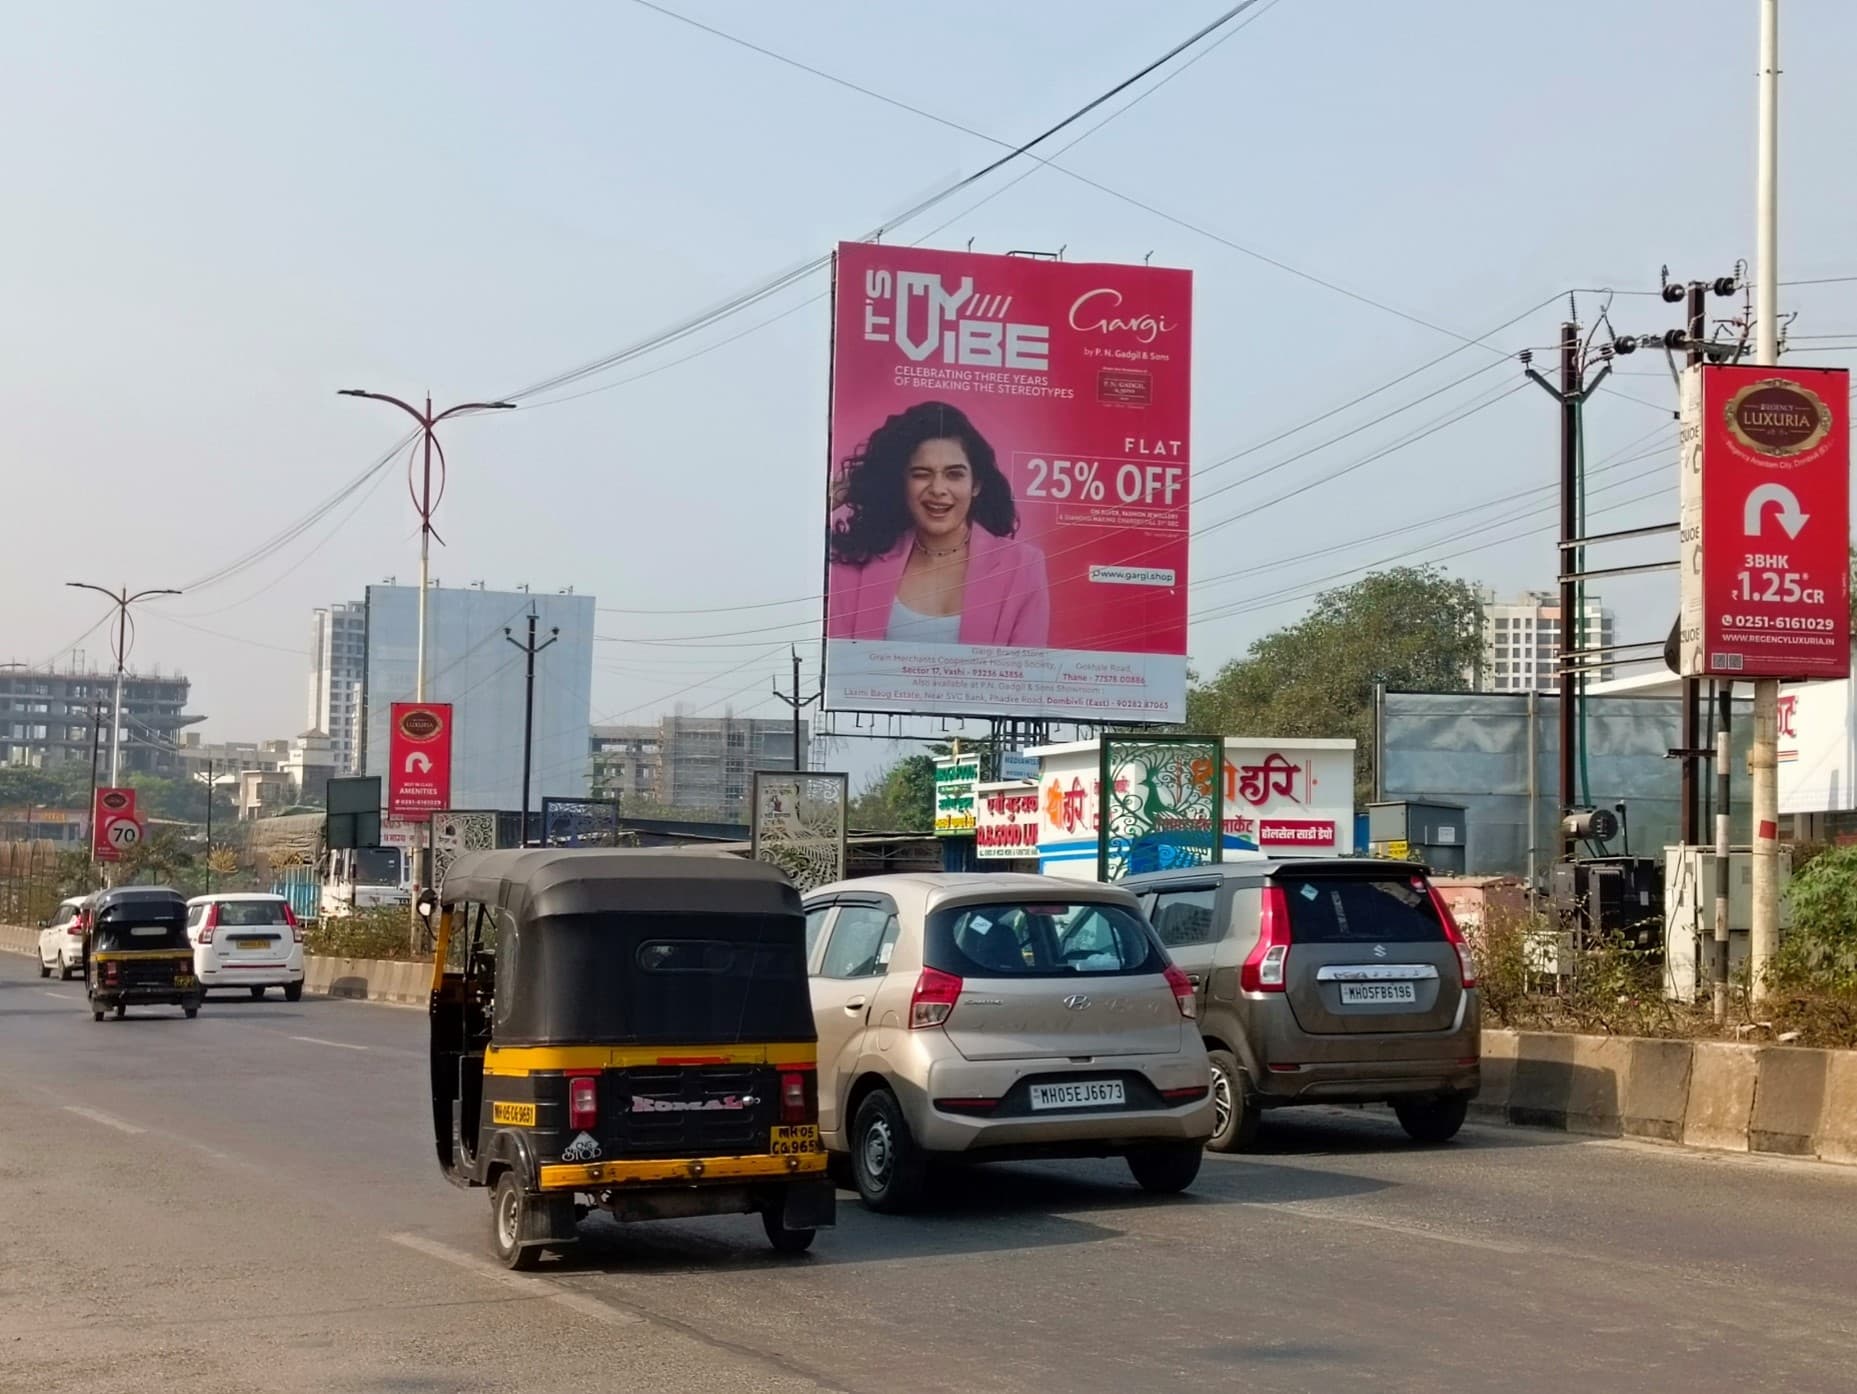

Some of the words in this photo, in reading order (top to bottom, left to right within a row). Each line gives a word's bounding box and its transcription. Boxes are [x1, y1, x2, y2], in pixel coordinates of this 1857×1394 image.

[896, 270, 974, 320] MY
[864, 269, 892, 342] IT'S
[1068, 287, 1179, 344] Gargi
[1084, 347, 1094, 357] by
[1115, 349, 1141, 360] Gadgil
[1150, 352, 1170, 361] Sons
[895, 365, 972, 381] CELEBRATING
[974, 371, 1010, 383] THREE
[1012, 374, 1048, 386] YEARS
[894, 376, 909, 387] OF
[913, 378, 970, 391] BREAKING
[973, 382, 995, 393] THE
[997, 384, 1074, 399] STEREOTYPES
[1760, 403, 1794, 412] REGENCY
[1743, 411, 1811, 428] LUXURIA
[1124, 438, 1182, 456] FLAT
[1026, 458, 1105, 500] 25%
[1116, 464, 1183, 505] OFF
[1744, 553, 1789, 569] 3BHK
[1100, 570, 1173, 582] www.gargi.shop
[1735, 615, 1834, 630] 0251-6161029
[1722, 633, 1835, 646] WWW.REGENCYLUXURIA.IN
[902, 666, 929, 674] Sector
[944, 668, 965, 676] Vashi
[1063, 673, 1087, 682] Thane
[912, 678, 933, 687] Also
[934, 679, 968, 689] available
[1046, 696, 1083, 705] Dombivli
[1085, 698, 1109, 708] (East)
[1239, 753, 1302, 806] हरि
[400, 787, 438, 795] AMENITIES
[1063, 776, 1088, 834] हरि
[113, 827, 136, 843] 70
[1348, 985, 1412, 1000] MH05FB6196
[1041, 1083, 1123, 1104] MH05EJ6673
[561, 1146, 603, 1162] STOP
